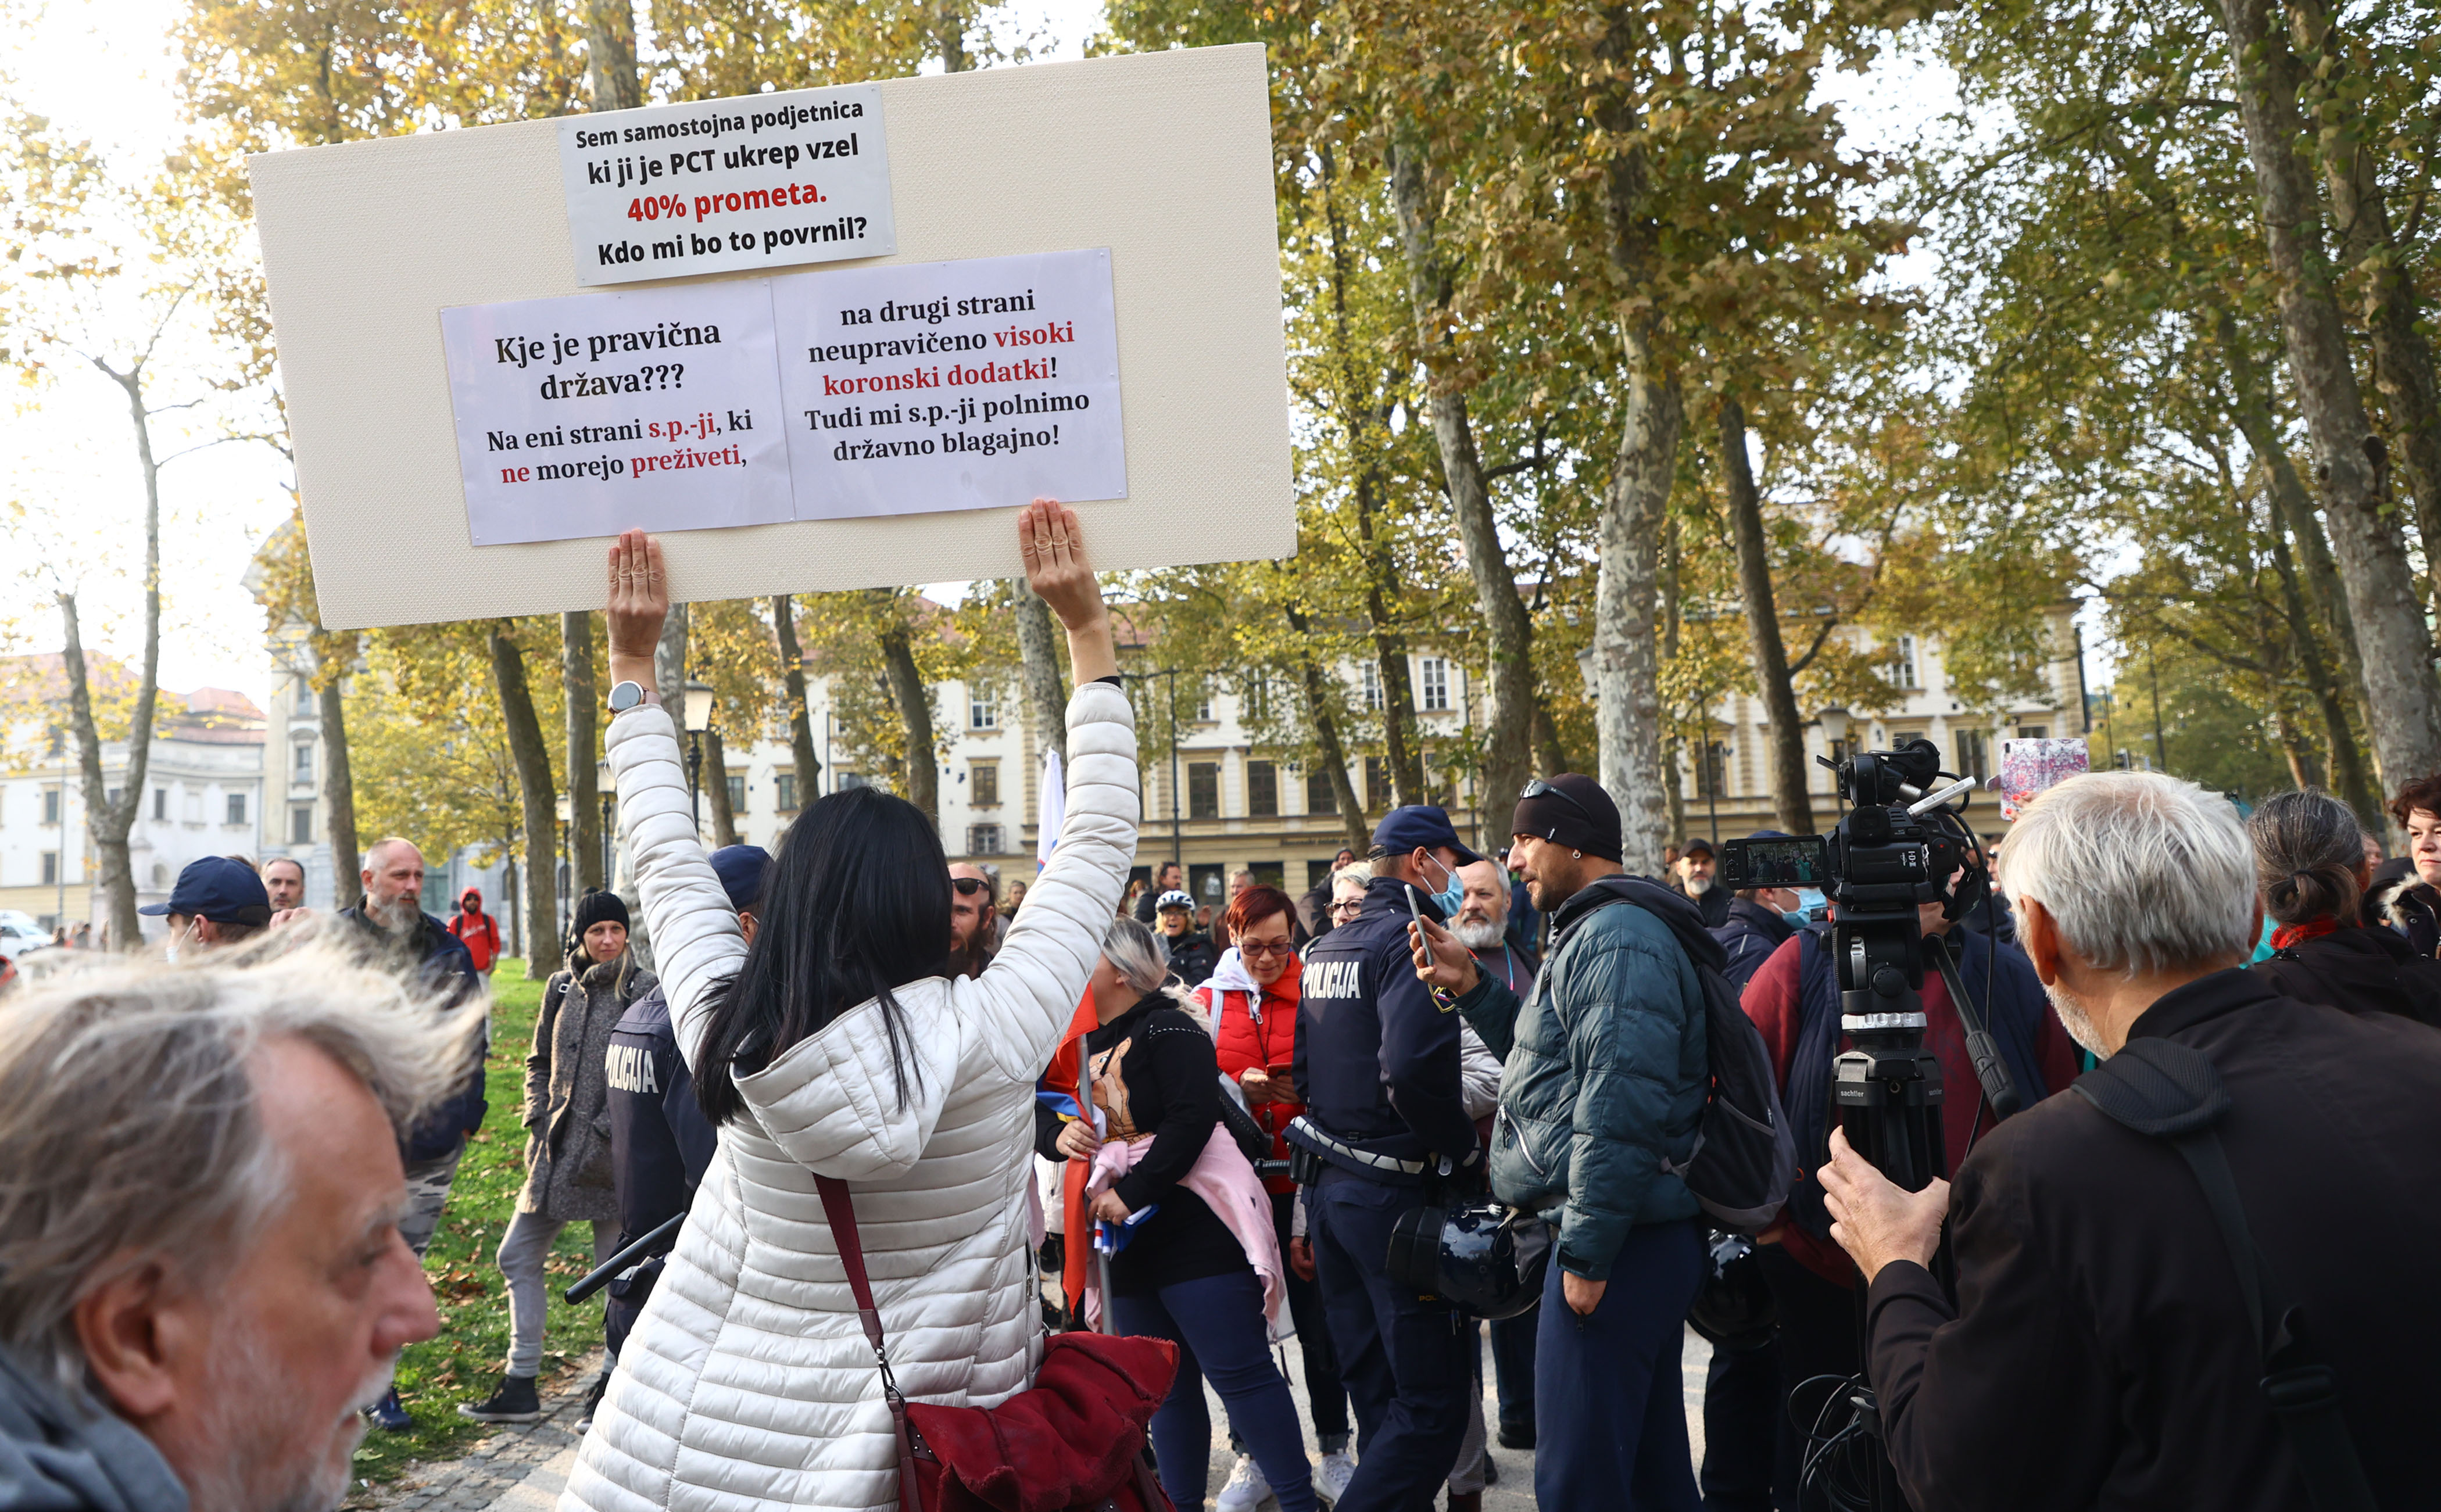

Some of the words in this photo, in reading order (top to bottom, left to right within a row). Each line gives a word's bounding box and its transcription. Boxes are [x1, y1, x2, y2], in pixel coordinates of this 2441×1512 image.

[576, 130, 618, 149] Sem
[624, 113, 745, 143] samostojna
[751, 100, 863, 134] podjetnica
[588, 159, 611, 185] ki
[617, 157, 633, 188] ji
[639, 155, 663, 185] je
[670, 149, 715, 175] PCT
[724, 144, 800, 170] ukrep
[806, 132, 858, 160] vzel
[627, 194, 687, 222] 40%
[694, 182, 827, 223] prometa.
[598, 240, 645, 266] Kdo
[652, 234, 684, 260] mi
[690, 233, 722, 256] bo
[728, 231, 756, 252] to
[763, 216, 867, 255] povrnil?
[840, 308, 874, 326] na
[879, 296, 951, 325] drugi
[957, 288, 1036, 316] strani
[494, 336, 545, 369] Kje
[552, 332, 579, 366] je
[587, 321, 722, 362] pravična
[808, 331, 987, 365] neupravičeno
[993, 320, 1075, 347] visoki
[540, 363, 684, 400] država???
[822, 366, 941, 396] koronski
[947, 356, 1057, 386] dodatki!
[486, 431, 520, 452] Na
[525, 425, 565, 448] eni
[570, 418, 643, 445] strani
[648, 412, 722, 442] s.p.-ji,
[726, 409, 753, 431] ki
[804, 406, 864, 431] Tudi
[868, 403, 903, 426] mi
[908, 397, 977, 427] s.p.-ji
[982, 392, 1089, 423] polnimo
[833, 438, 935, 461] državno
[941, 424, 1059, 456] blagajno!
[500, 467, 530, 483] ne
[536, 454, 624, 481] morejo
[630, 443, 747, 479] preživeti,
[1302, 961, 1361, 999] POLICIJA
[604, 1044, 659, 1094] POLICIJA
[1840, 1090, 1864, 1098] sachtler
